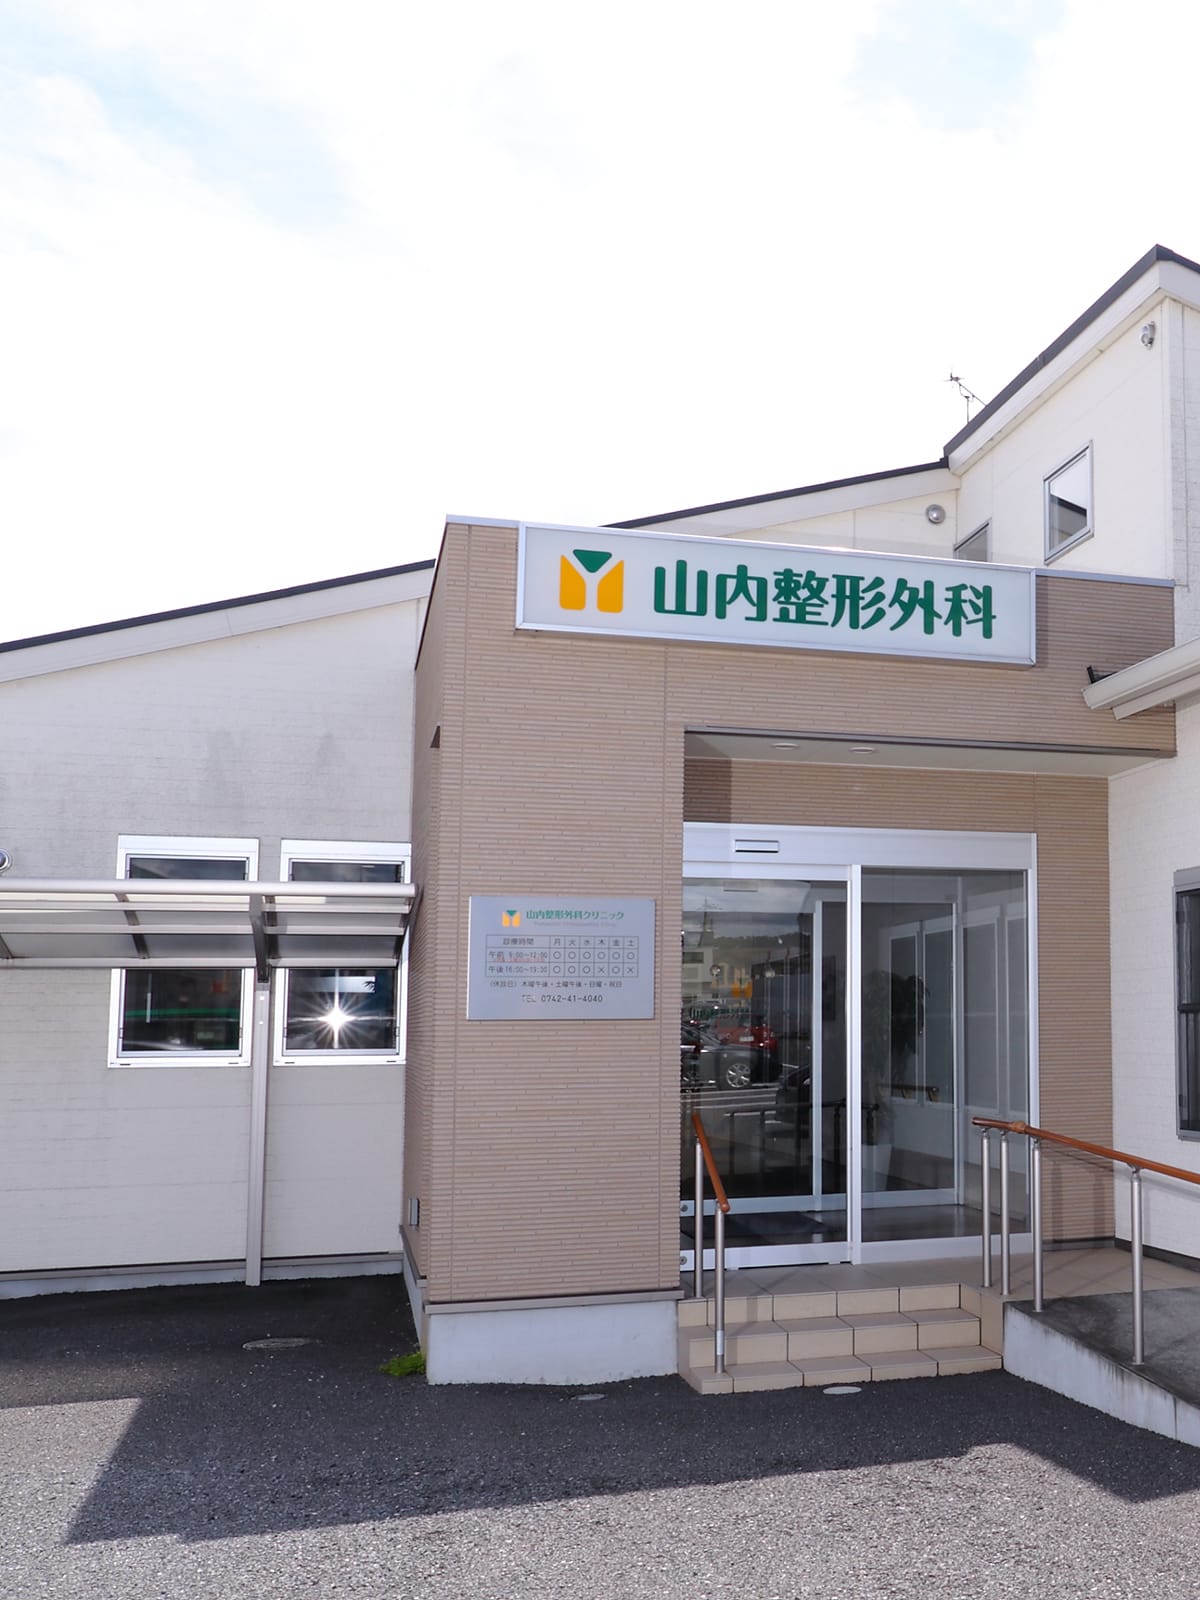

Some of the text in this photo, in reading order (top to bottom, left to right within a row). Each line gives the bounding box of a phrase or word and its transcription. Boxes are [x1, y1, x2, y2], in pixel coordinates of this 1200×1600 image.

[653, 559, 996, 639] 山内整形外科
[526, 910, 624, 920] 山内整形外科クリニック
[541, 994, 603, 1003] 0742-41-4040
